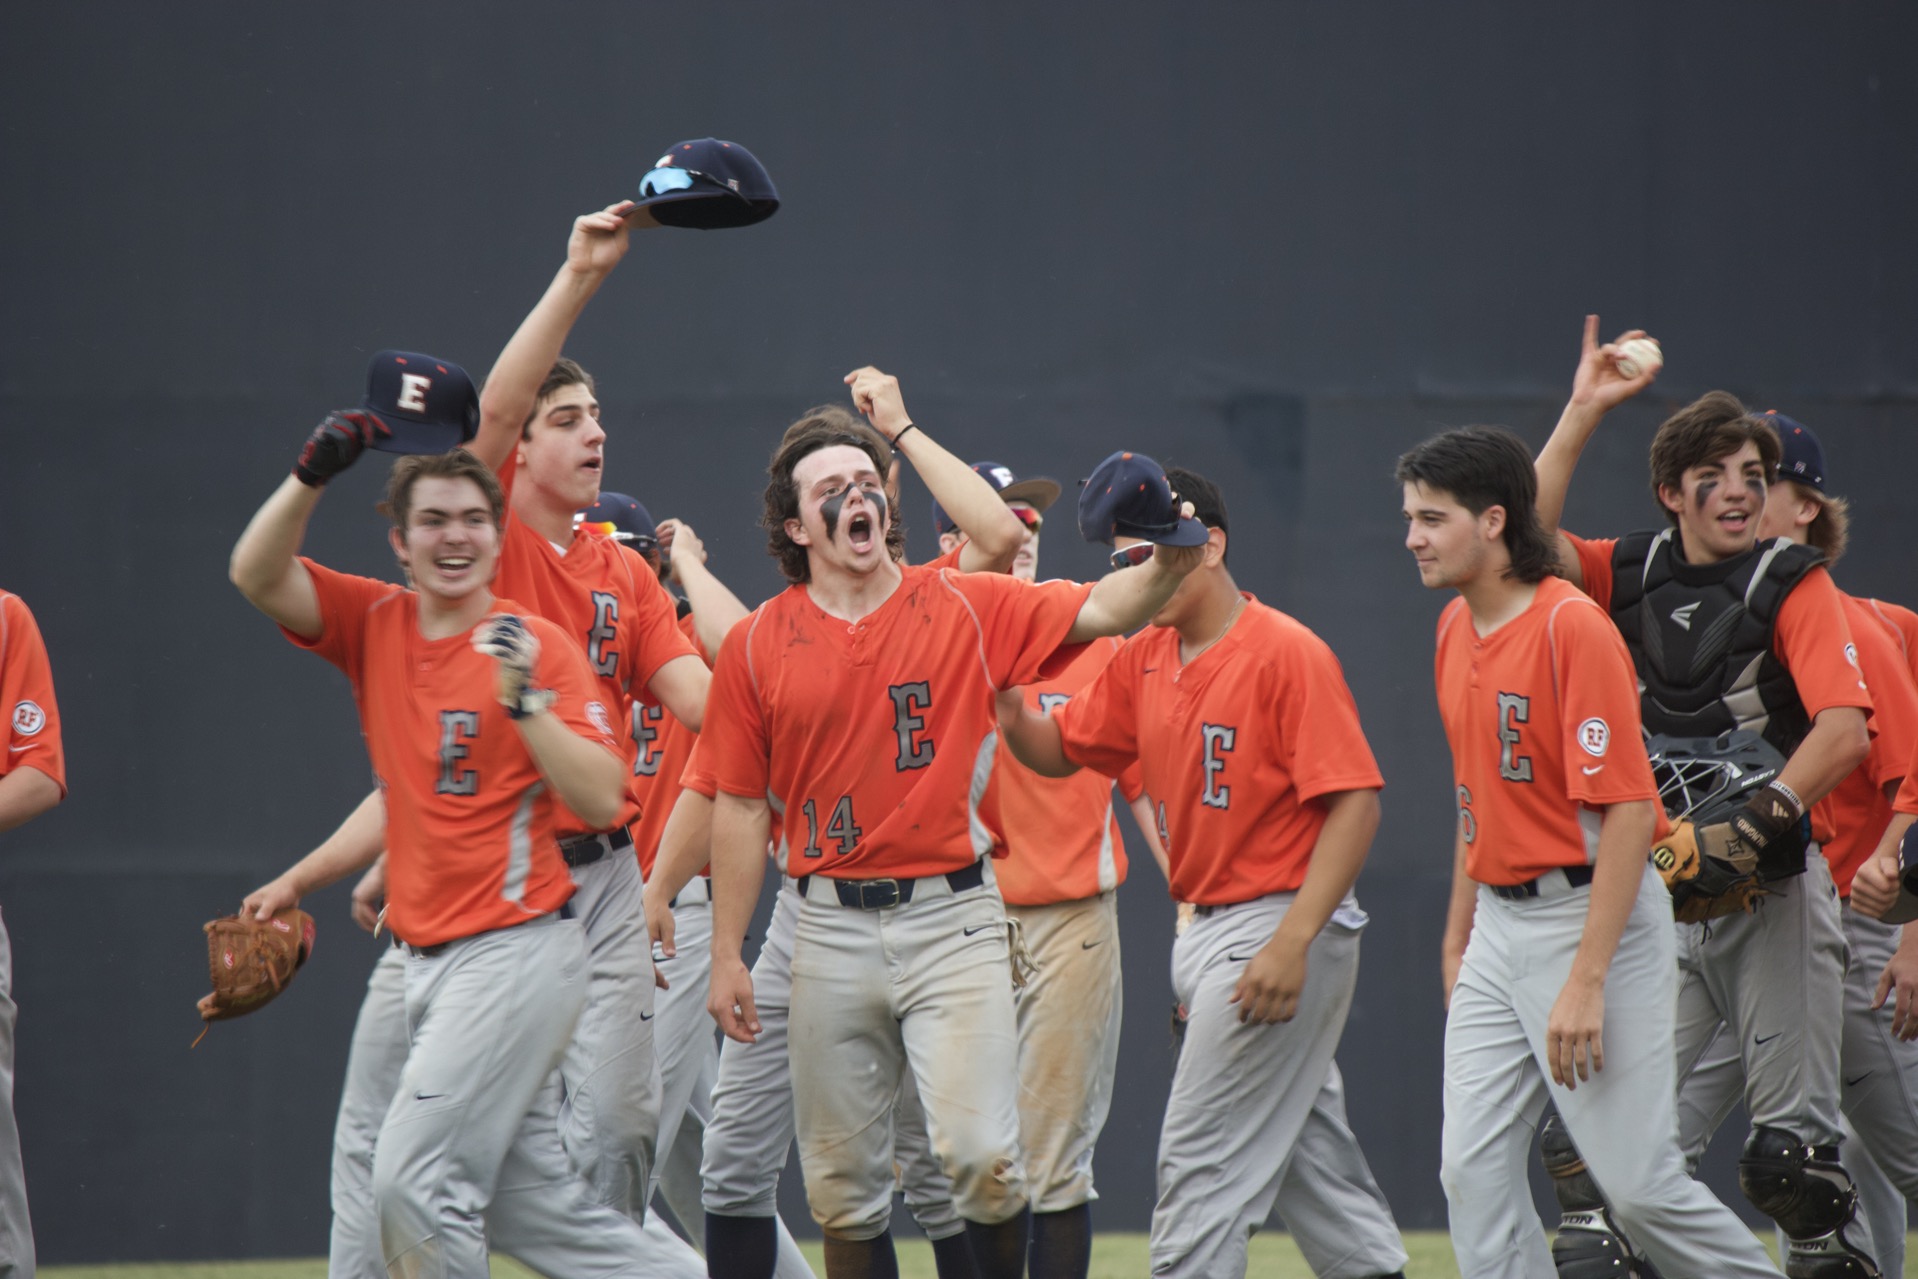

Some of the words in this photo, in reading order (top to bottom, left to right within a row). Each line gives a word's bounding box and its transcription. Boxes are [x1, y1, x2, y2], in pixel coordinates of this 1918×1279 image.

[397, 372, 432, 414] E
[588, 590, 620, 678] E
[434, 709, 479, 796] E
[632, 700, 664, 776] E
[888, 680, 935, 773] E
[1202, 722, 1236, 811] E
[1498, 689, 1534, 783] E
[802, 795, 863, 858] 14
